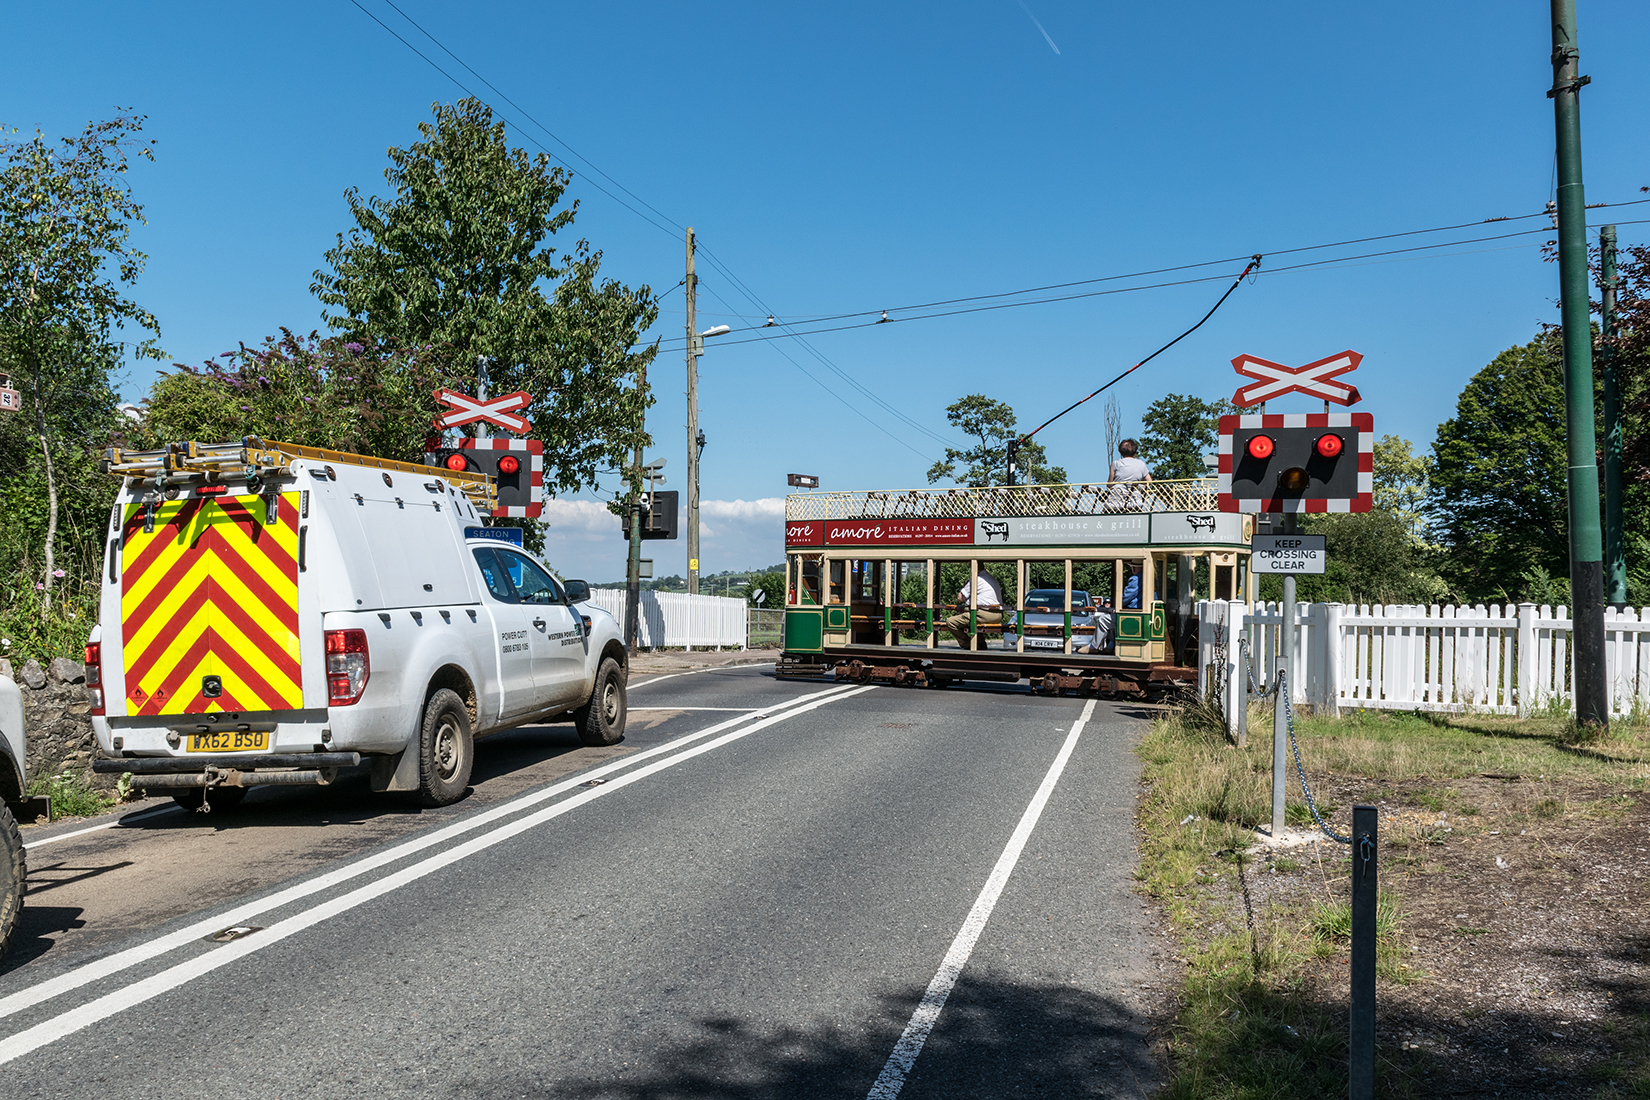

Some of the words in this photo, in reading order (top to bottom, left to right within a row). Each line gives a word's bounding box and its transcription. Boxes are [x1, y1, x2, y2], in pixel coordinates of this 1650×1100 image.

[1019, 520, 1088, 530] steakhouse
[1096, 521, 1103, 529] &
[1111, 519, 1142, 531] grill
[1191, 517, 1214, 525] Shed
[830, 523, 885, 539] amoré
[987, 523, 1007, 532] Shed
[473, 530, 509, 538] SEATON
[1275, 540, 1302, 548] KEEP
[1260, 550, 1317, 559] CROSSING
[1271, 561, 1305, 569] CLEAR
[502, 631, 517, 640] POWER
